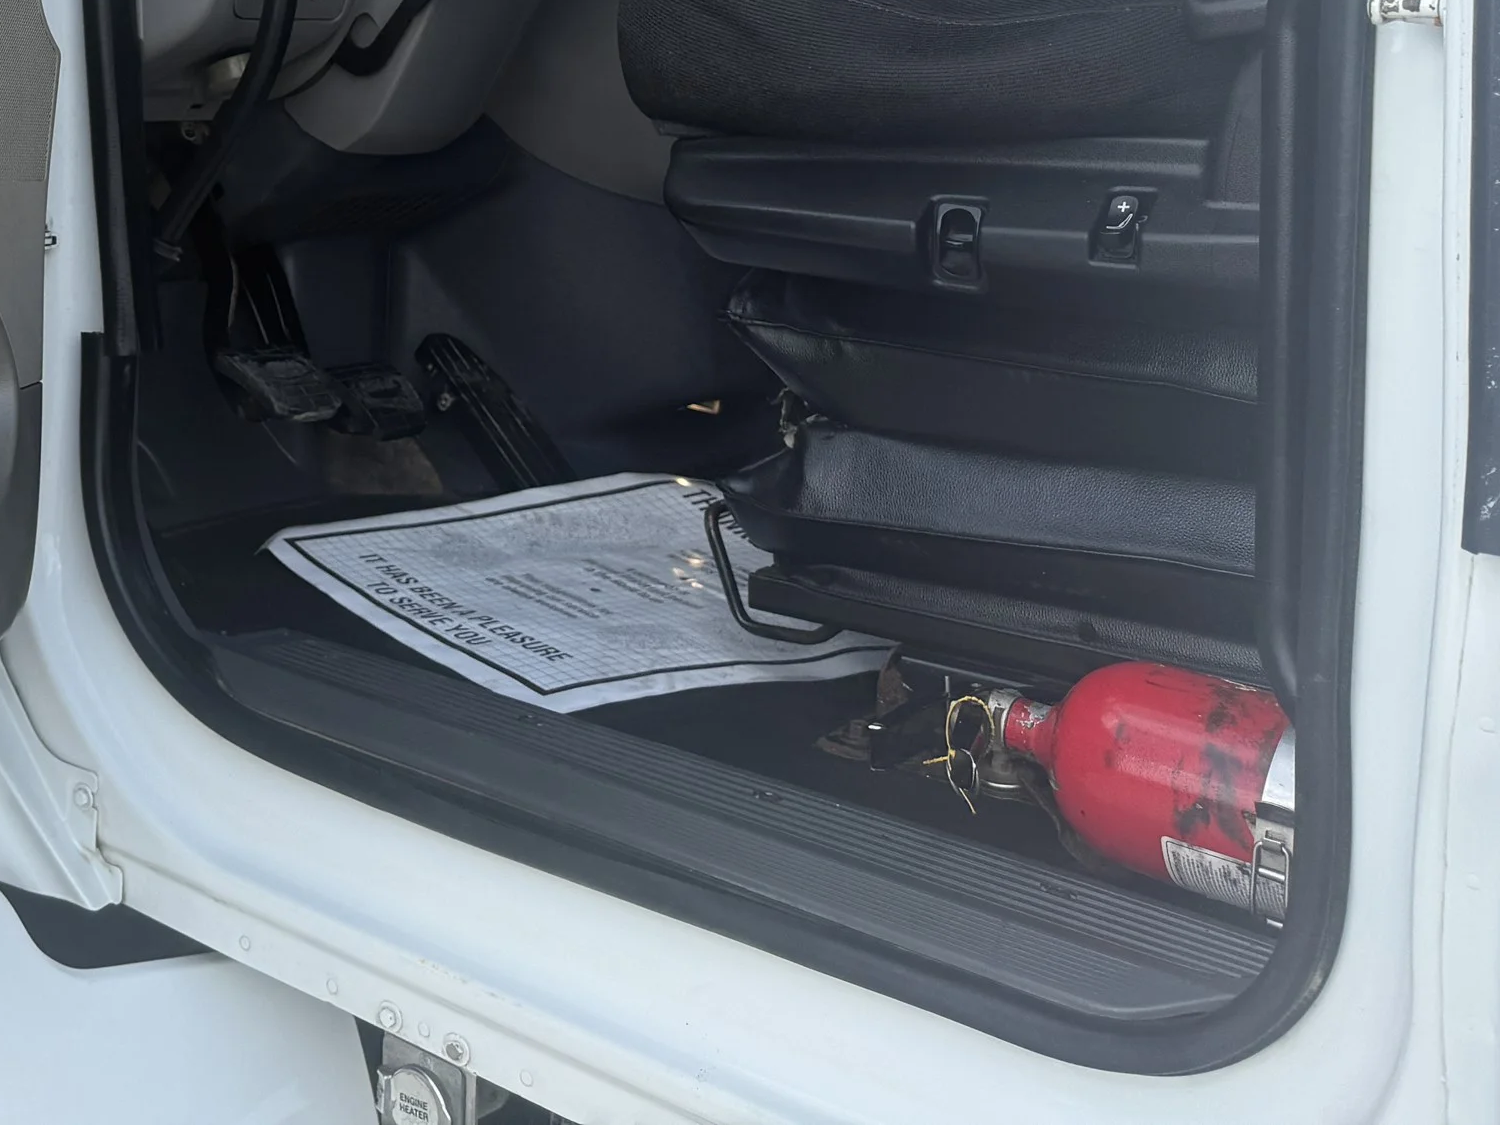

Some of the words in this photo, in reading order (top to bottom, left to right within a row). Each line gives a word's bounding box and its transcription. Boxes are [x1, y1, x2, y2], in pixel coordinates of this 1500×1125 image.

[359, 553, 388, 564] IT
[375, 564, 419, 586] HAS
[409, 586, 463, 611] BEEN
[457, 608, 476, 621] A
[468, 615, 574, 662] PLEASURE
[367, 581, 397, 596] TO
[389, 595, 454, 627] SERVE
[446, 624, 491, 646] YOU
[399, 1092, 428, 1111] ENGINE
[399, 1103, 429, 1122] HEATER
